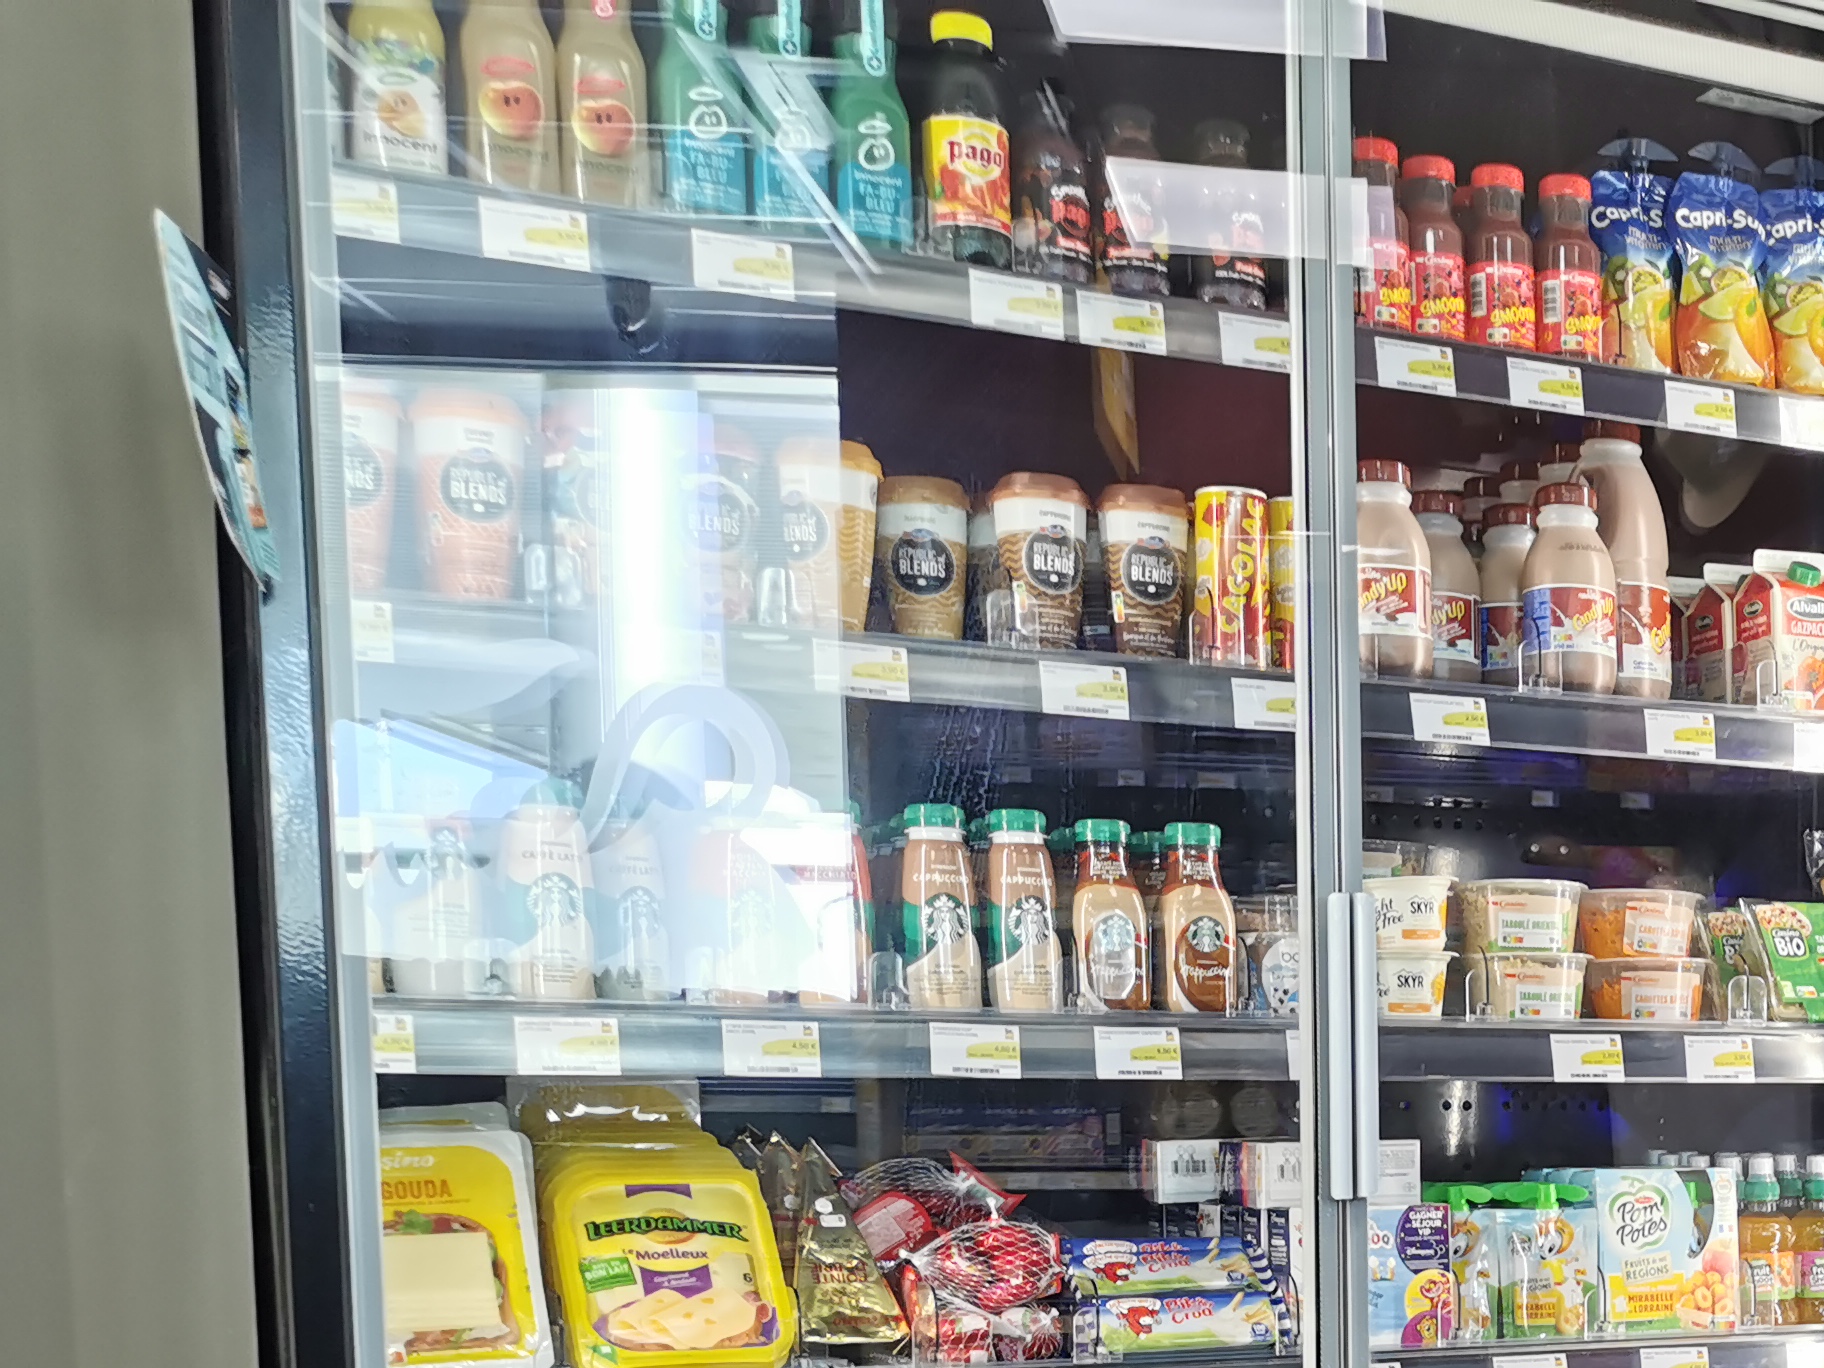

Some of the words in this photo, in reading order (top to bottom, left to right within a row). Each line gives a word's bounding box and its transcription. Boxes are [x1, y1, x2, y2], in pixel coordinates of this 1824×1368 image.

[948, 138, 1003, 171] pago
[1675, 207, 1768, 244] Capri-Sun
[898, 559, 947, 579] BLENDS
[1033, 555, 1076, 575] BLENDS
[1218, 497, 1266, 636] CACOLAC
[1130, 566, 1173, 586] BLENDS
[912, 872, 970, 886] CAPPUCCINO
[1409, 901, 1435, 916] SKYR
[1396, 974, 1424, 989] SKYR
[381, 1178, 453, 1200] GOUDA
[1409, 1210, 1445, 1222] GAGNER
[584, 1215, 750, 1242] LEERDAMMER
[1418, 1227, 1431, 1236] VIP
[1616, 1215, 1668, 1247] Potes
[635, 1247, 709, 1261] Moelleux
[742, 1272, 753, 1284] 6
[1627, 1292, 1674, 1305] MIRABELLE
[1633, 1302, 1674, 1314] LORRAINE
